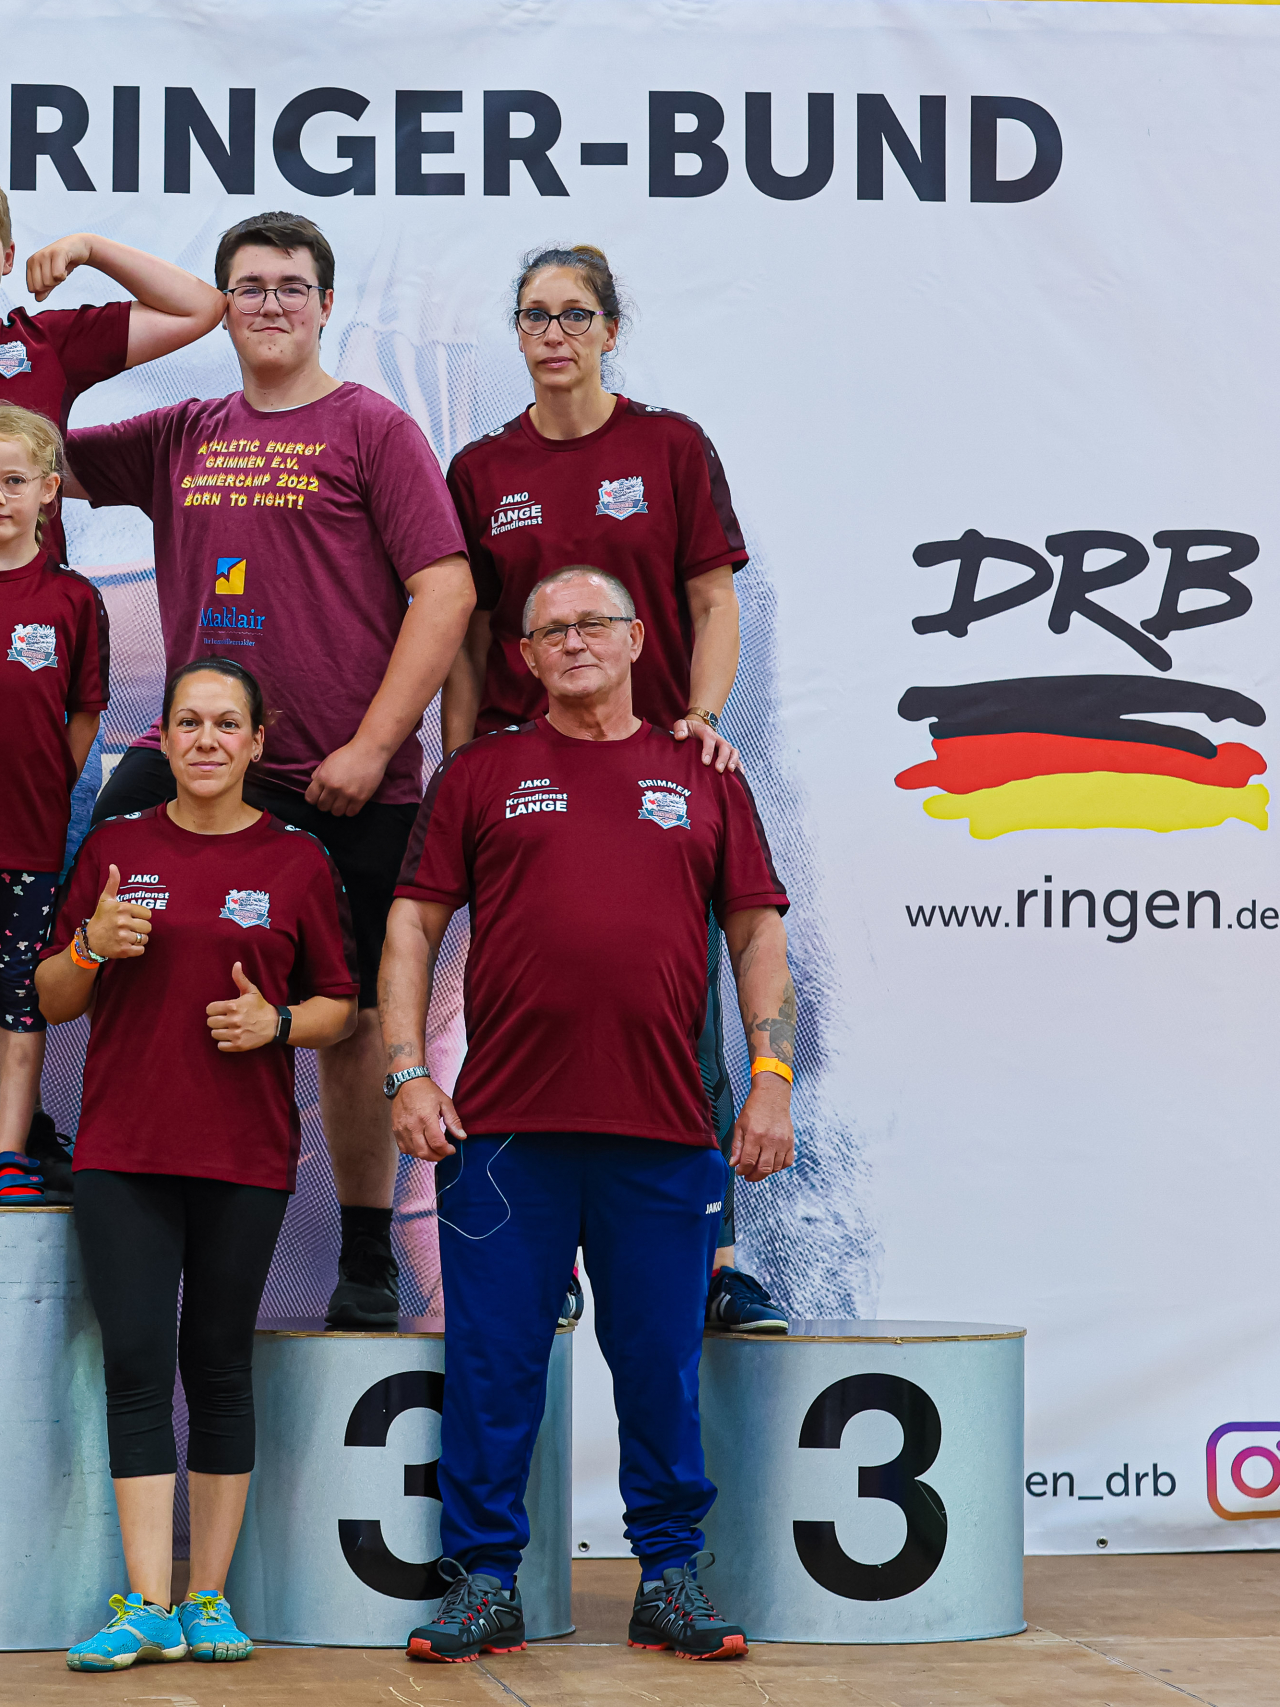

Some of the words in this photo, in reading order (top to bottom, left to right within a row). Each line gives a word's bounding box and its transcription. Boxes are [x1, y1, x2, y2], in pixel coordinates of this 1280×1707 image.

[9, 83, 1063, 203] RINGER-BUND
[198, 438, 260, 454] ATHLETIC
[265, 440, 326, 455] ENERGY
[206, 455, 266, 468] GRIMMEN
[271, 456, 299, 470] E.V.
[181, 472, 271, 488] SUMMERCAMP
[276, 472, 319, 492] 2022
[183, 490, 221, 506] BORN
[230, 491, 247, 507] TO
[253, 491, 305, 509] FIGHT!
[500, 491, 529, 505] JAKO
[491, 504, 542, 528] LANGE
[491, 516, 543, 536] Krandienst
[911, 528, 1260, 672] DRB
[199, 606, 265, 629] Maklair
[519, 778, 550, 789] JAKO
[637, 779, 691, 797] GRIMMEN
[506, 793, 568, 807] Krandienst
[506, 800, 568, 819] LANGE
[128, 874, 159, 884] JAKO
[905, 875, 1280, 943] www.ringen.de
[705, 1200, 722, 1215] JAKO
[338, 1370, 444, 1601] 3
[792, 1373, 948, 1602] 3
